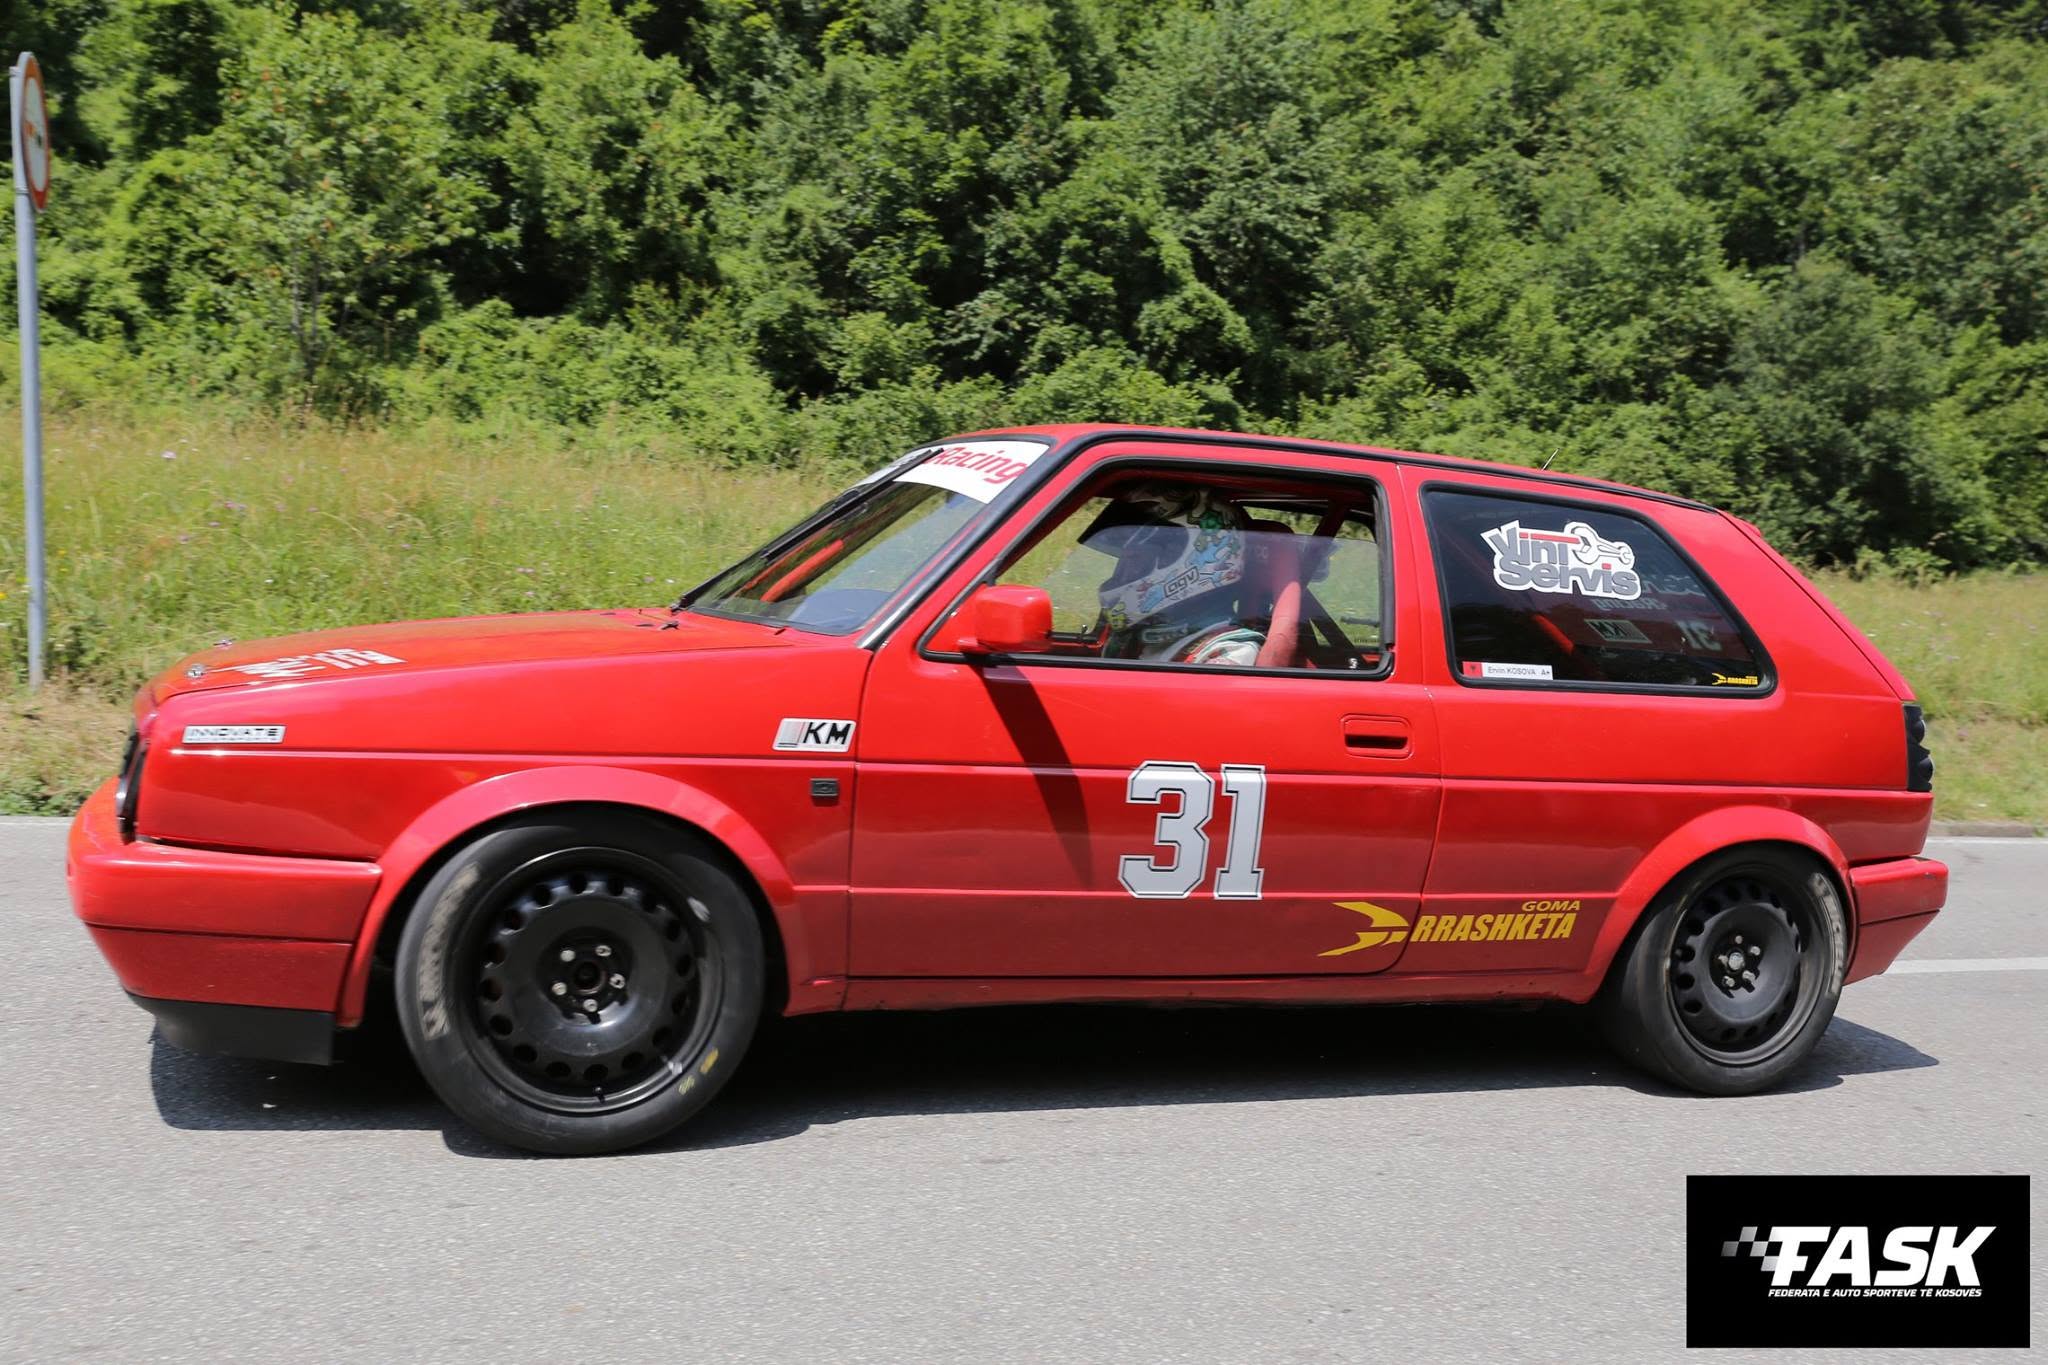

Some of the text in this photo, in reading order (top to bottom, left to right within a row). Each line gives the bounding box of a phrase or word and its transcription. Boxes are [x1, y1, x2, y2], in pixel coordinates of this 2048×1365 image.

[924, 447, 1029, 484] Racing
[1487, 525, 1579, 566] Vini
[1498, 553, 1640, 597] Servis
[1507, 666, 1536, 676] KOSOVA
[803, 722, 852, 745] KM
[1118, 760, 1267, 900] 31
[1521, 900, 1581, 912] GOMA
[1410, 913, 1577, 942] RRASHKETA
